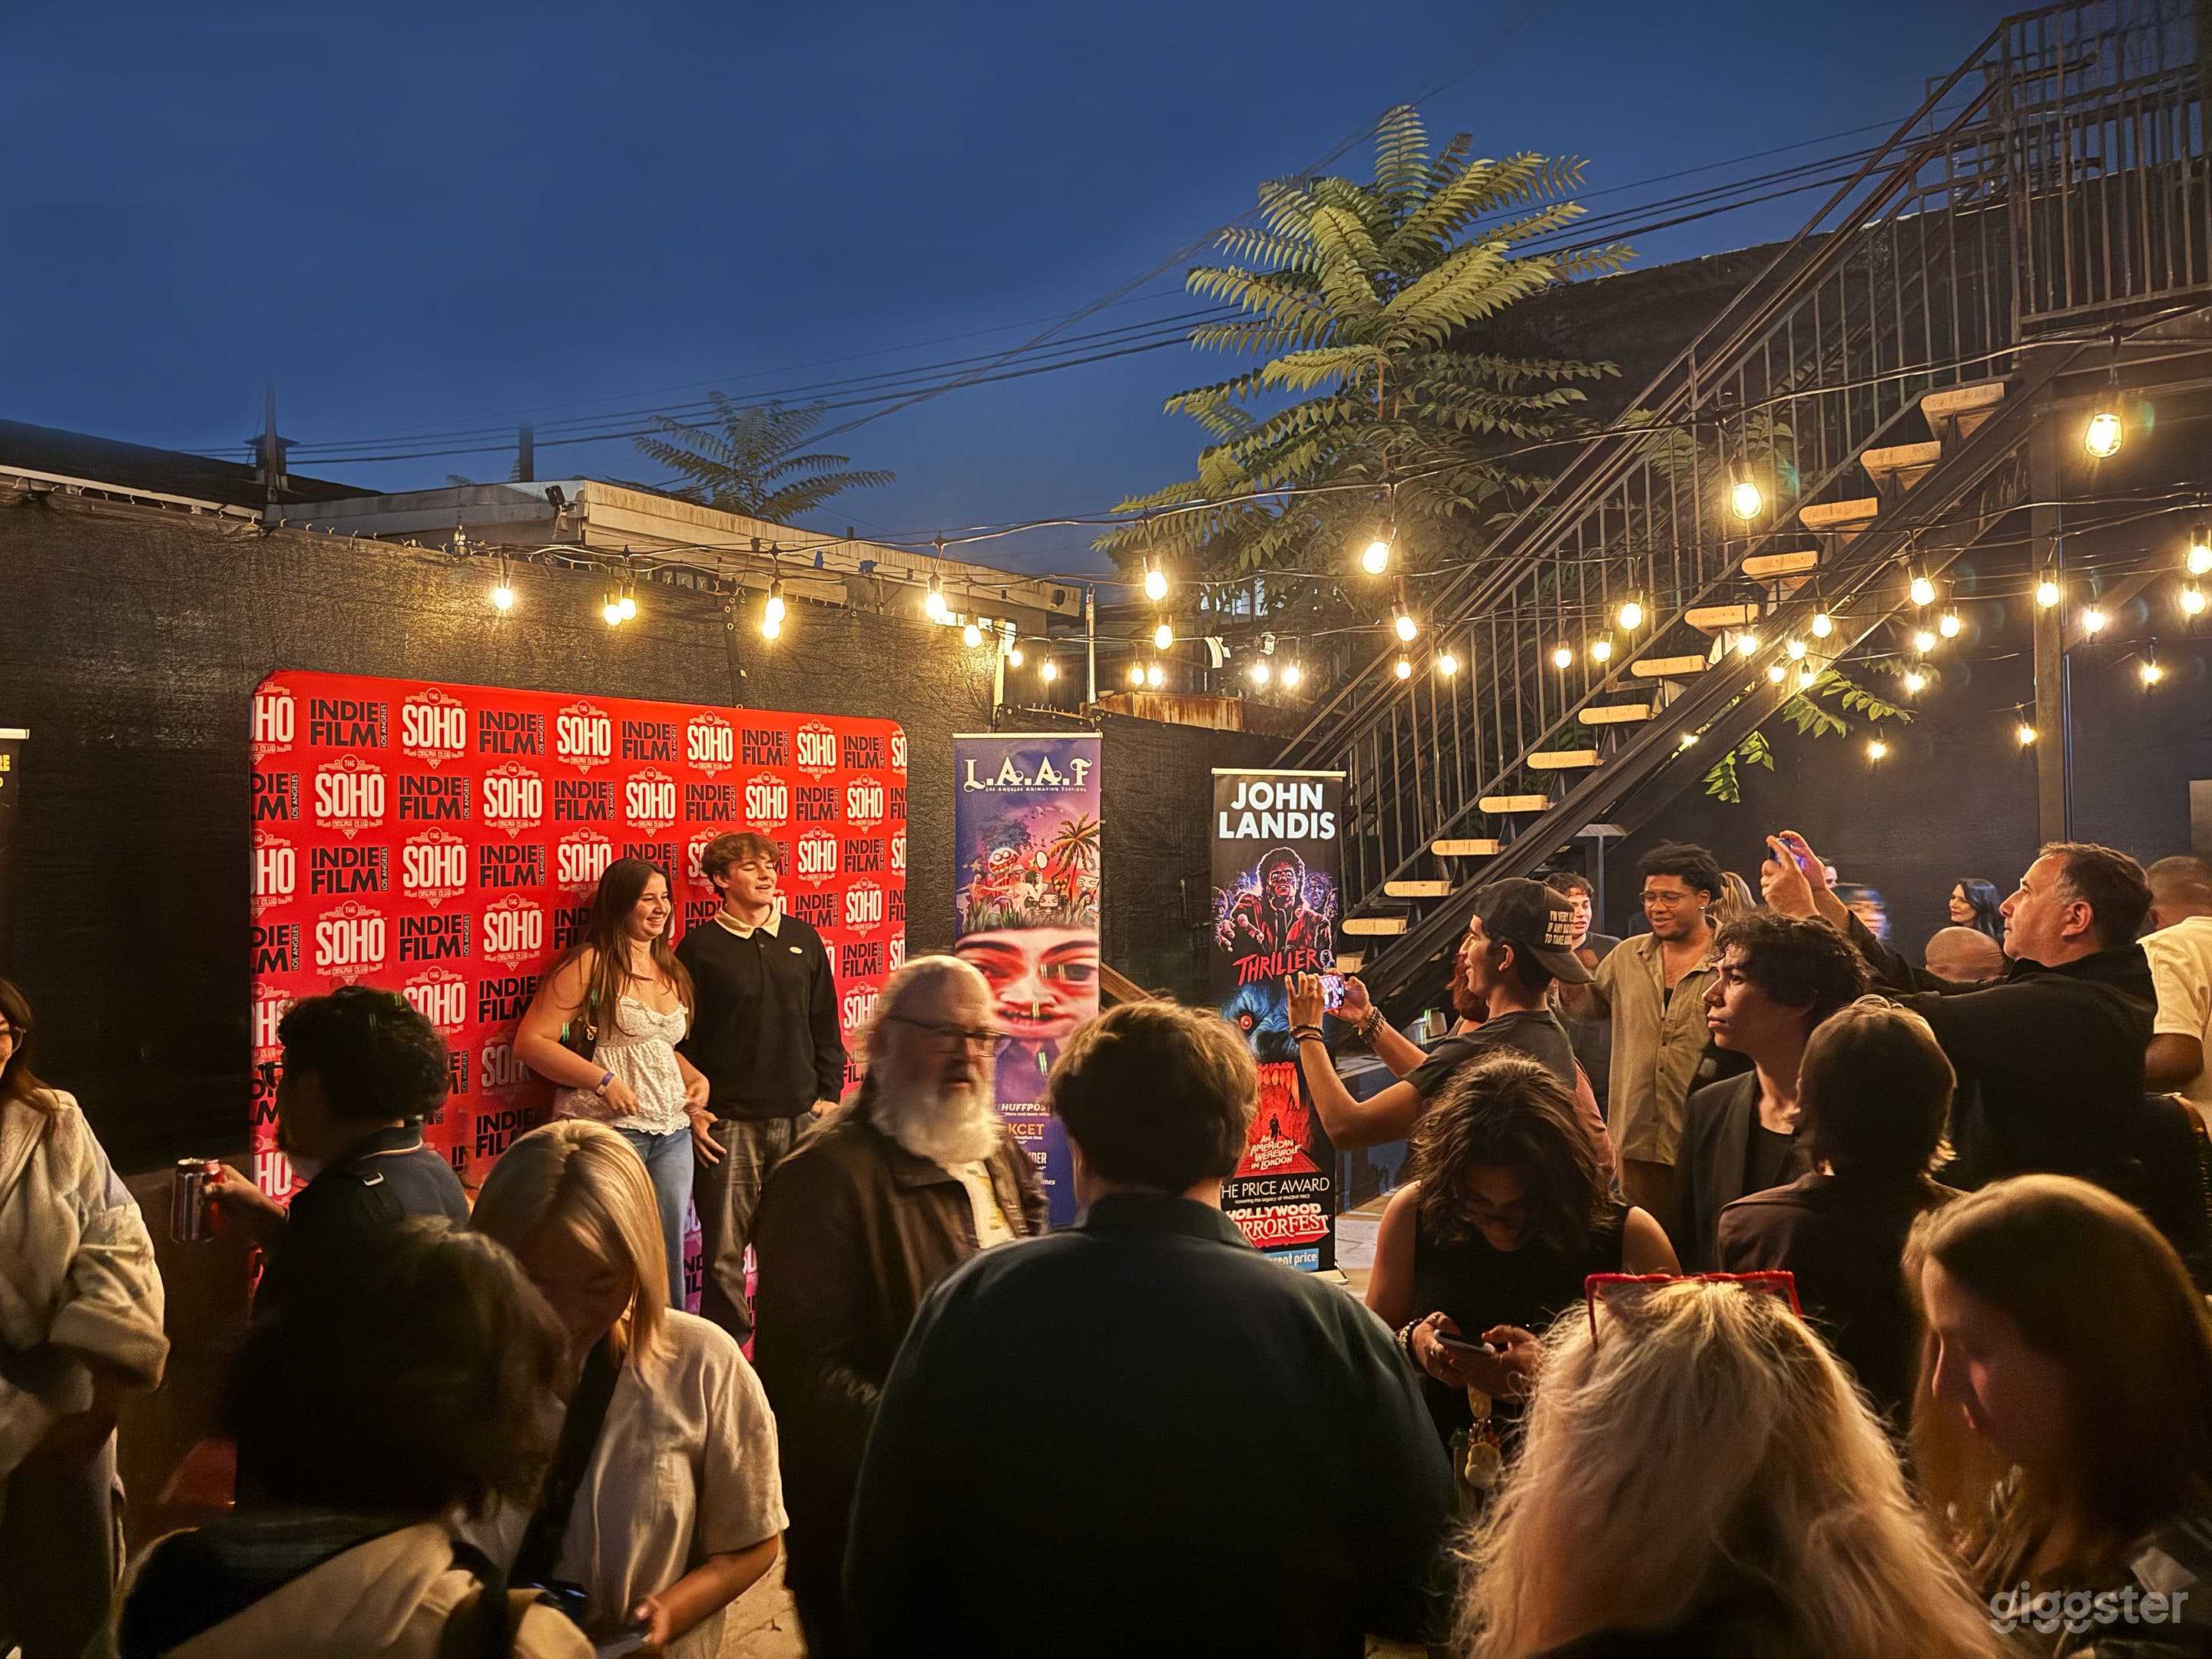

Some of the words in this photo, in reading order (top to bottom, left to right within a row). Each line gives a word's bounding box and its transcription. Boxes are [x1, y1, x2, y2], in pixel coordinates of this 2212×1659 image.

[251, 696, 294, 743] HO
[310, 699, 379, 722] INDIE
[479, 710, 536, 732] INDIE
[310, 720, 377, 747] FILM
[402, 704, 466, 749] SOHO
[557, 716, 611, 757] SOHO
[622, 720, 670, 740] INDIE
[479, 730, 536, 755] FILM
[687, 725, 733, 762] SOHO
[742, 730, 783, 746] INDIE
[843, 735, 879, 751] INDIE
[622, 740, 670, 761] FILM
[743, 746, 783, 766] FILM
[796, 732, 836, 766] SOHO
[844, 751, 879, 769] FILM
[315, 773, 384, 817] SOHO
[399, 776, 462, 796] INDIE
[555, 780, 608, 799] INDIE
[686, 784, 730, 801] INDIE
[796, 787, 833, 802] INDIE
[1230, 782, 1323, 810] JOHN
[399, 796, 461, 820] FILM
[484, 777, 542, 818] SOHO
[626, 782, 675, 819] SOHO
[746, 785, 788, 820] SOHO
[847, 786, 883, 819] SOHO
[555, 800, 607, 820] FILM
[686, 801, 730, 821] FILM
[796, 803, 833, 820] FILM
[1219, 811, 1336, 839] LANDIS
[480, 845, 537, 863] INDIE
[623, 843, 671, 860] INDIE
[798, 839, 837, 873] SOHO
[845, 839, 879, 854] INDIE
[312, 847, 379, 868] INDIE
[403, 845, 466, 887] SOHO
[558, 844, 612, 882] SOHO
[845, 854, 879, 873] FILM
[312, 869, 378, 895] FILM
[480, 865, 537, 887] FILM
[796, 893, 833, 910] INDIE
[846, 889, 882, 923] SOHO
[399, 915, 462, 937] INDIE
[484, 910, 542, 952] SOHO
[316, 918, 385, 965] SOHO
[399, 935, 461, 962] FILM
[1545, 933, 1553, 944] TO
[843, 942, 877, 960] INDIE
[842, 958, 876, 978] FILM
[1233, 949, 1322, 986] THRILLER
[479, 976, 537, 999] INDIE
[476, 1108, 535, 1135] INDIE
[1008, 1123, 1045, 1135] KCET
[1250, 1139, 1293, 1157] AMERICAN
[1260, 1135, 1270, 1144] AN
[1254, 1144, 1302, 1162] WEREWOLF
[1260, 1156, 1293, 1171] LONDON
[1221, 1184, 1238, 1198] HE
[1242, 1181, 1277, 1197] PRICE
[1280, 1177, 1330, 1194] AWARD
[1226, 1203, 1321, 1220] HOLLYWOOD
[1294, 1252, 1317, 1266] price
